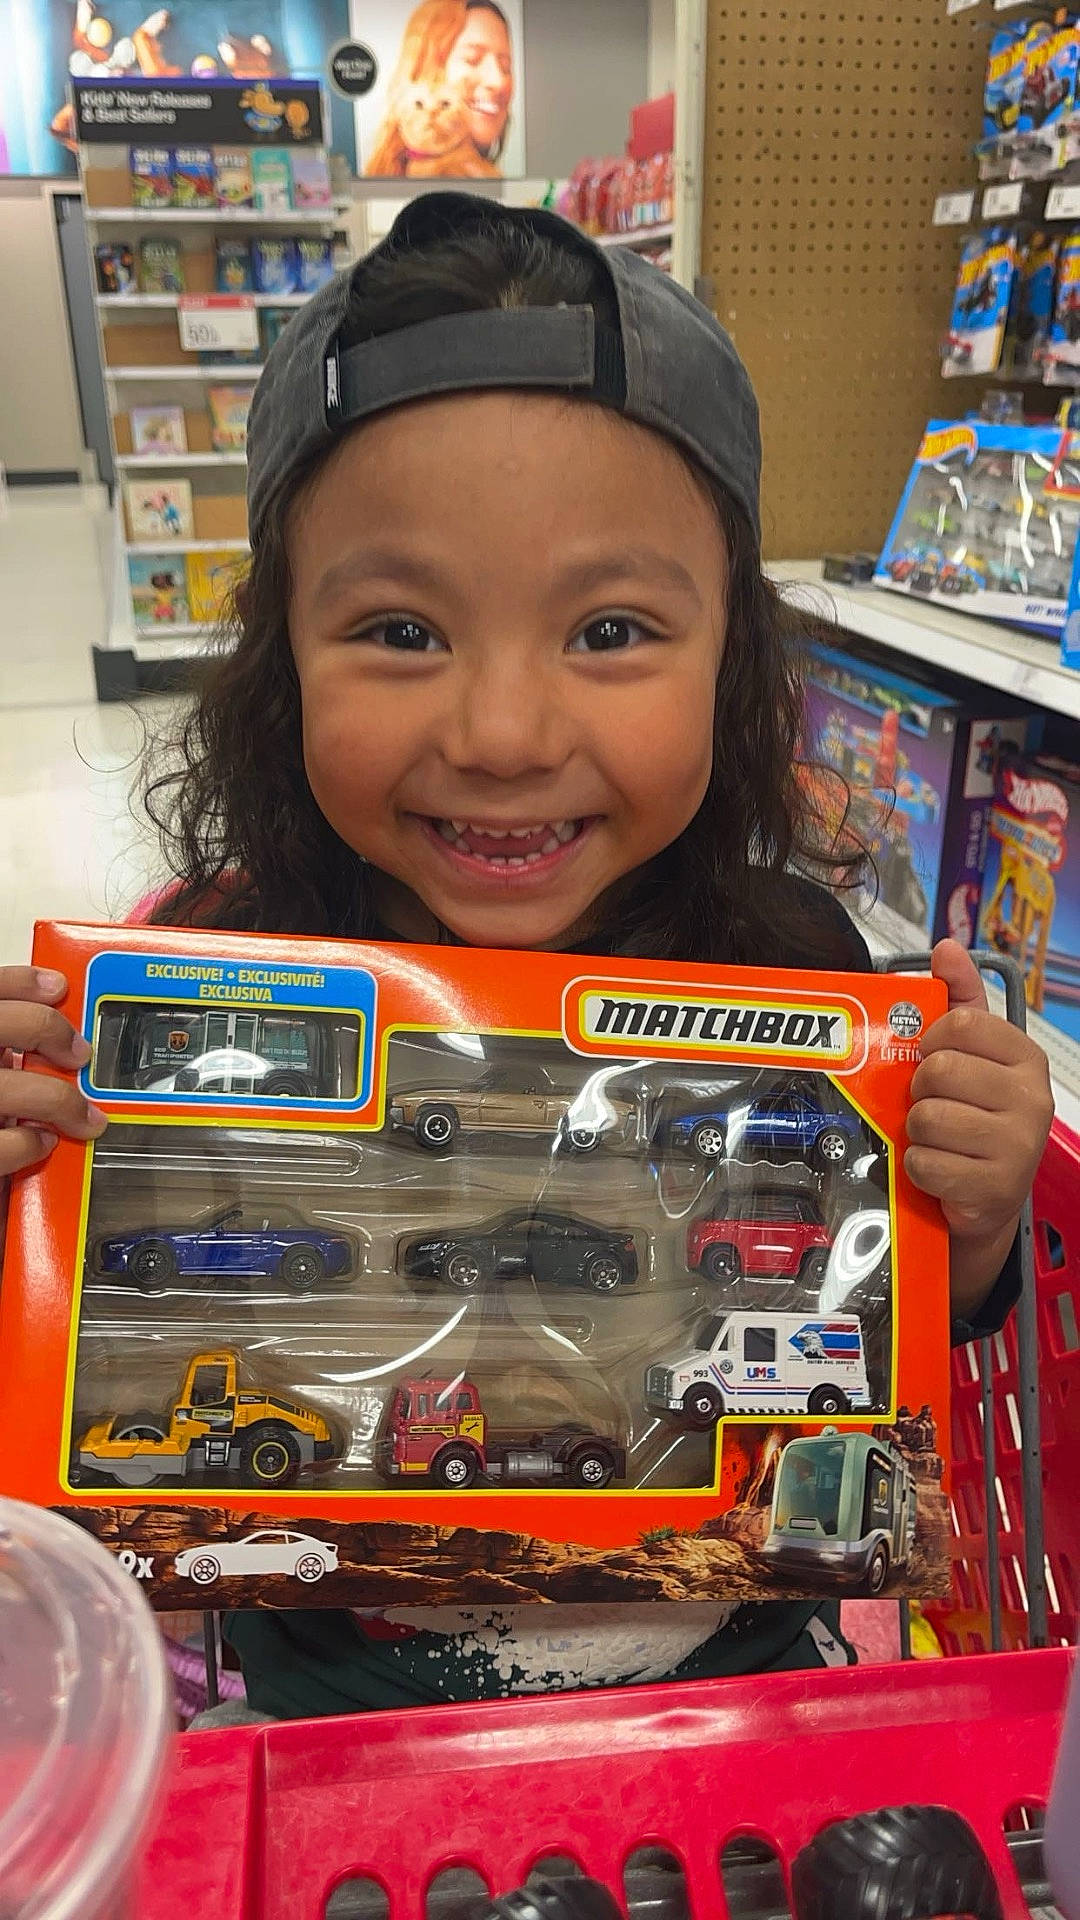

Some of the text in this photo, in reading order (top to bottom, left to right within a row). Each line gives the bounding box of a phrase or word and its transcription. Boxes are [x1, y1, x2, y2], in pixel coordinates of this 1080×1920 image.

[117, 91, 148, 108] New
[150, 91, 212, 109] Releases
[95, 109, 128, 123] Best
[129, 109, 176, 124] Sellers
[146, 963, 325, 988] EXCLUSIVE! EXCLUSIVITÉ!
[199, 983, 273, 1002] EXCLUSIVA
[595, 998, 840, 1049] MATCHBOX
[891, 1015, 920, 1026] METAL
[693, 1369, 709, 1378] 993
[746, 1366, 777, 1379] UMS
[119, 1550, 155, 1579] 9x
